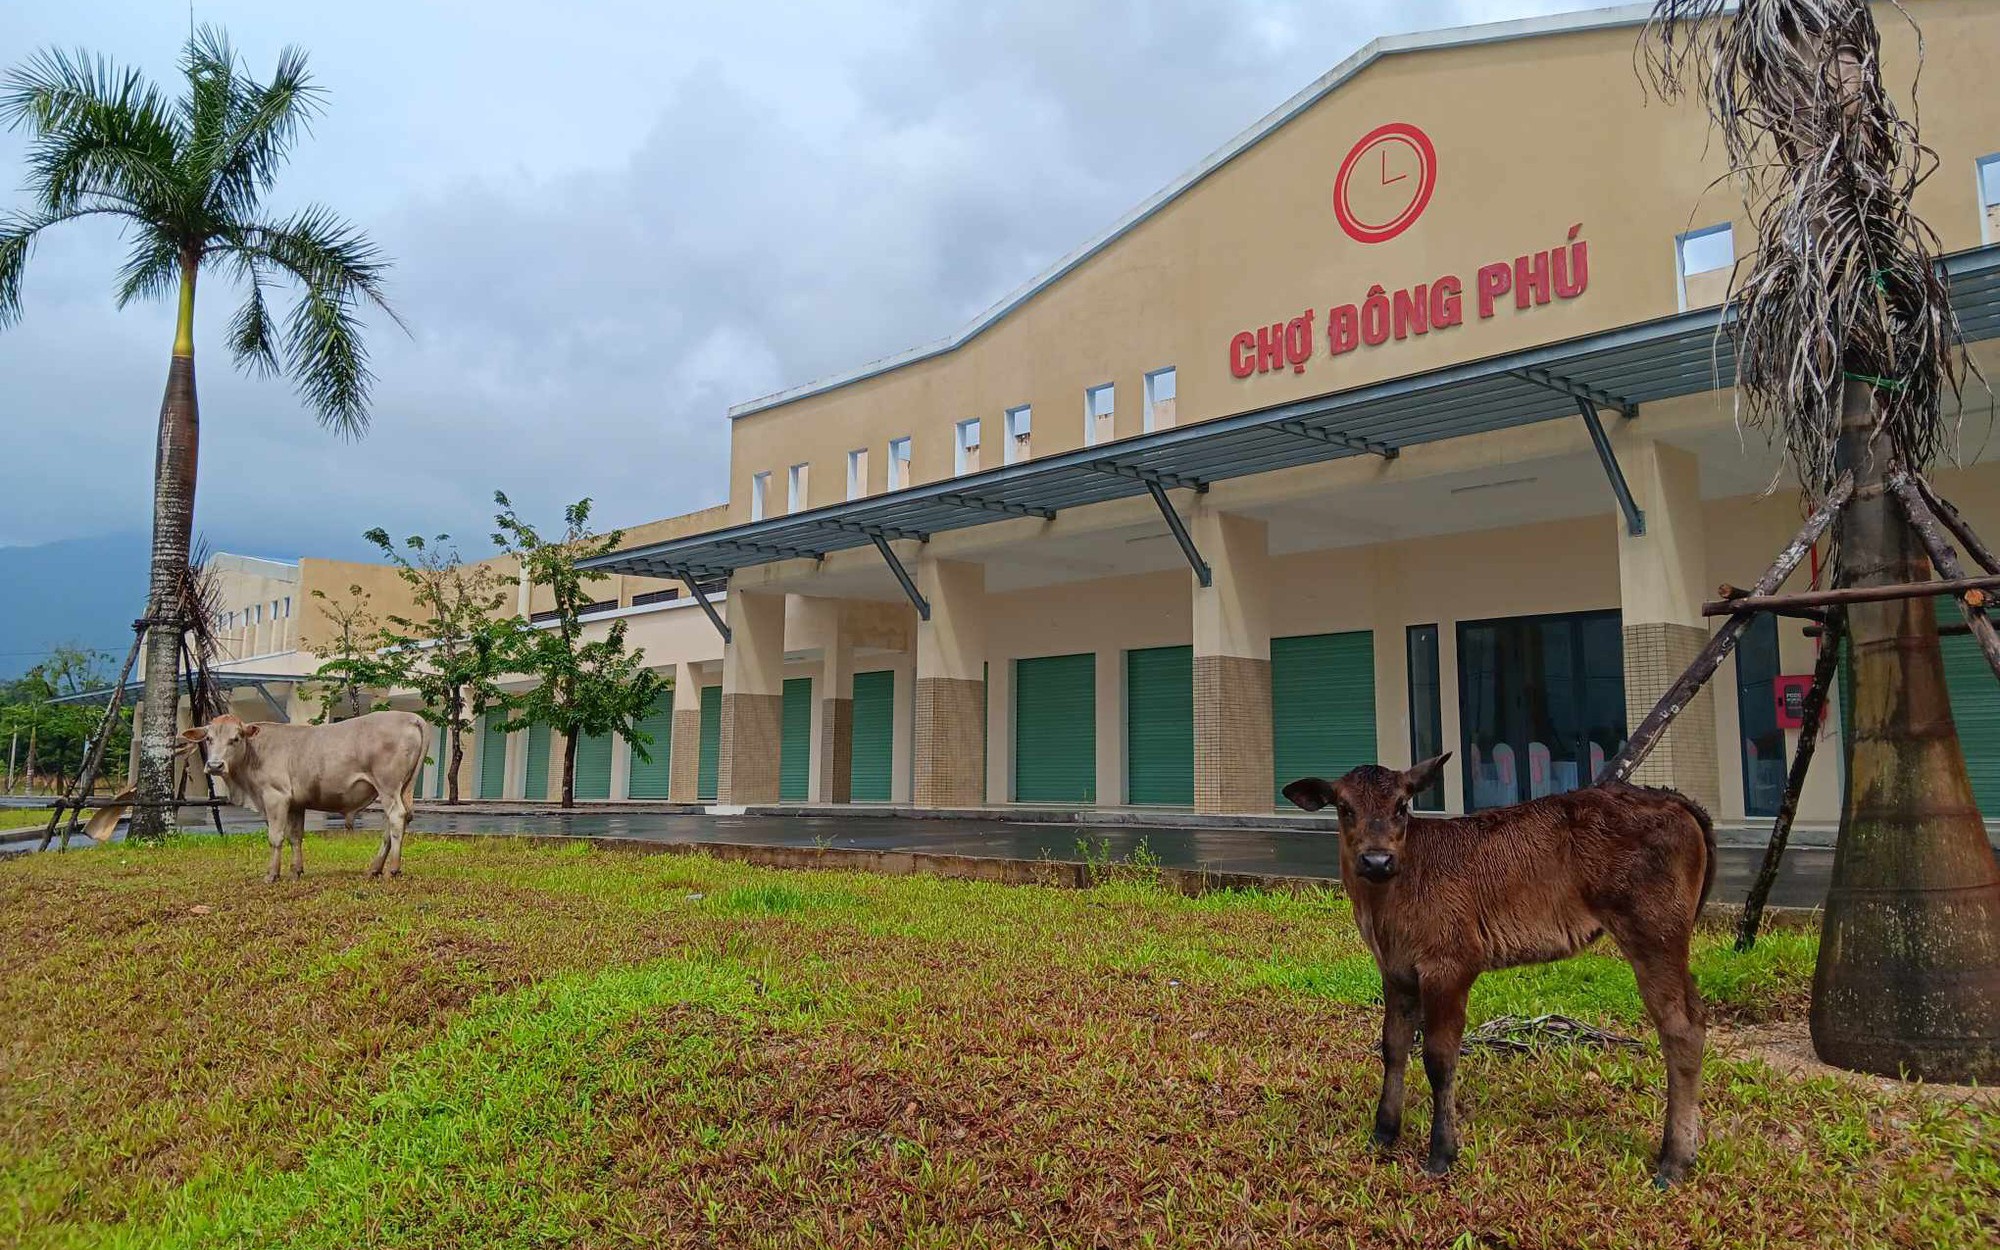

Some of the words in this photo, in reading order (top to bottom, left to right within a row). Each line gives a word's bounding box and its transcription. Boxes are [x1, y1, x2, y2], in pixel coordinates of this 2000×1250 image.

[1229, 307, 1315, 378] CHỢ
[1327, 275, 1464, 356] ĐÔNG
[1477, 223, 1589, 318] PHÚ
